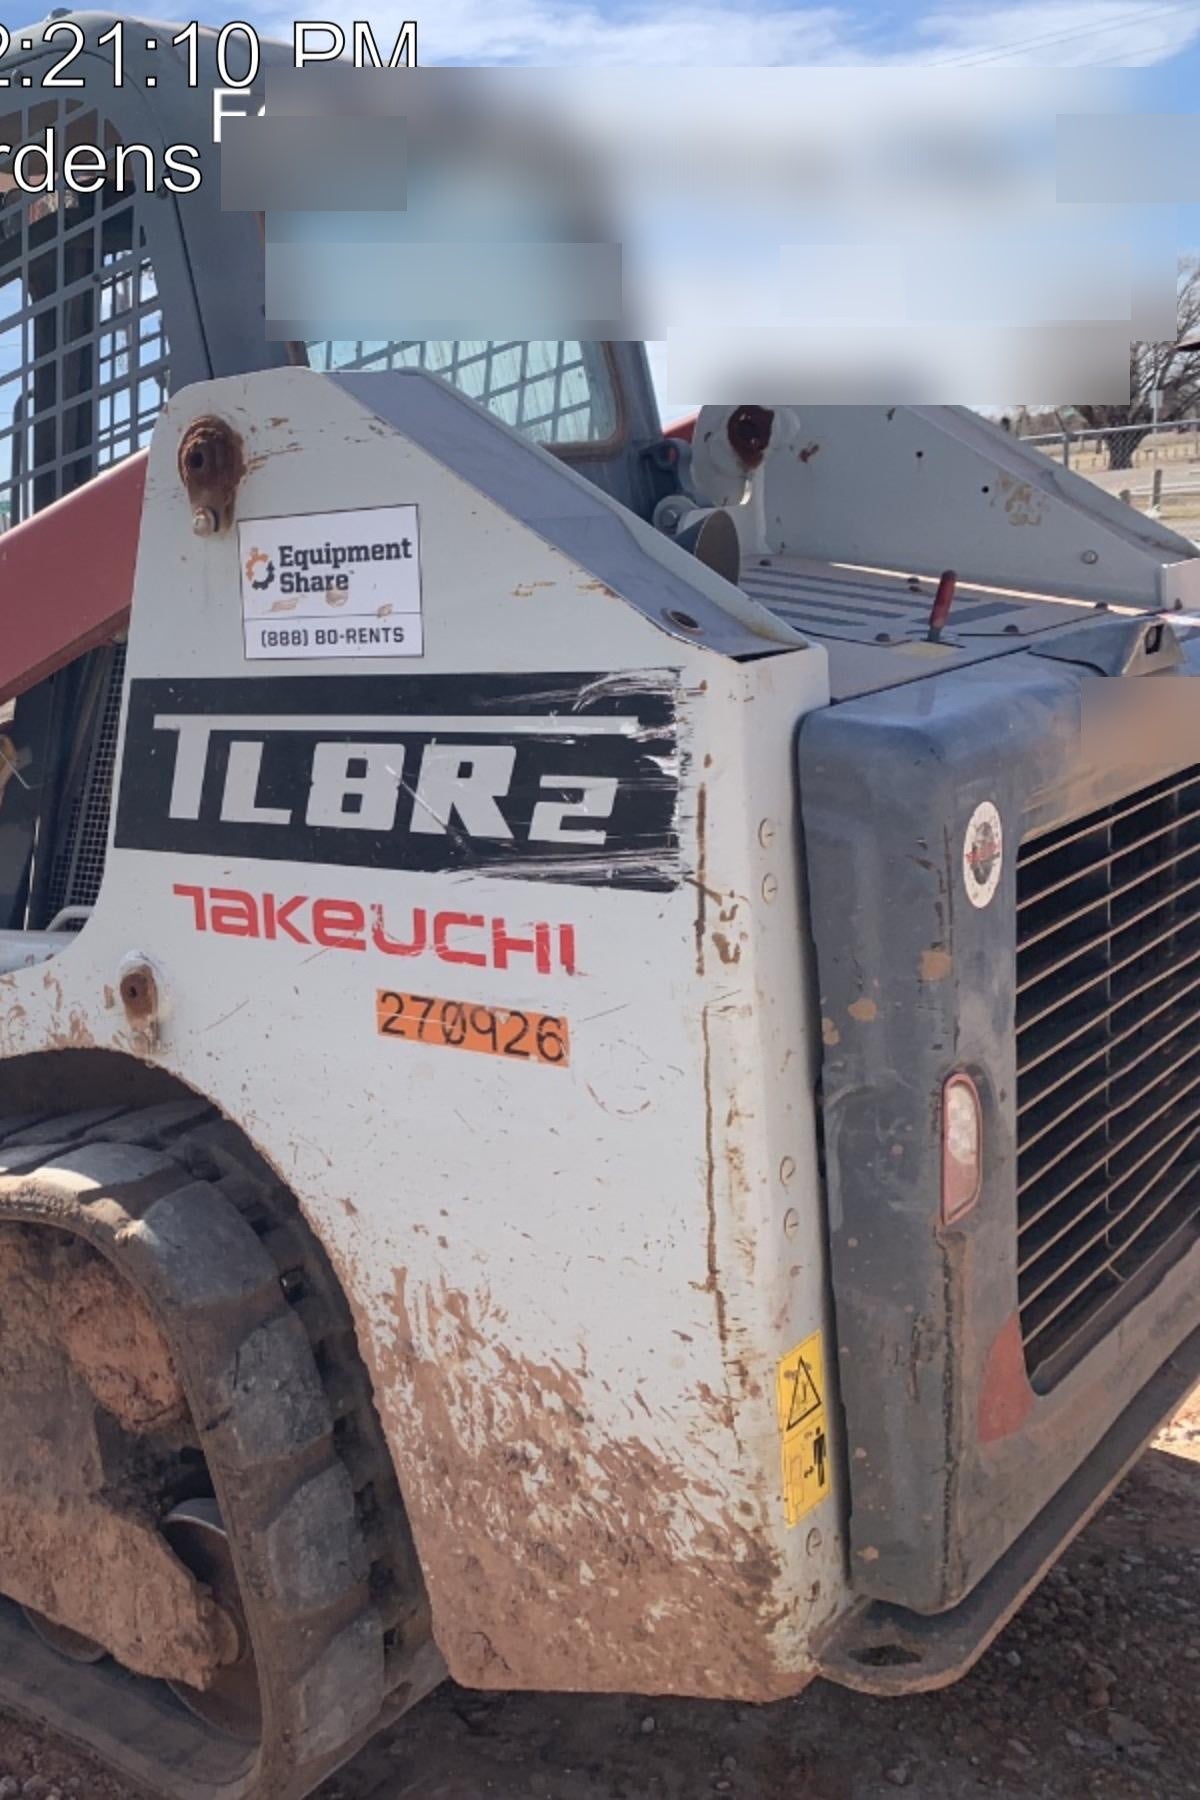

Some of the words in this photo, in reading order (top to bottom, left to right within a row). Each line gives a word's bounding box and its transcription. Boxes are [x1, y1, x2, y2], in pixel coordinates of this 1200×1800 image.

[277, 537, 413, 571] Equipment
[279, 571, 349, 595] Share
[261, 629, 309, 648] (888)
[315, 626, 405, 646] 80-RENTS
[153, 713, 639, 846] TL8R2
[379, 991, 568, 1062] 270926
